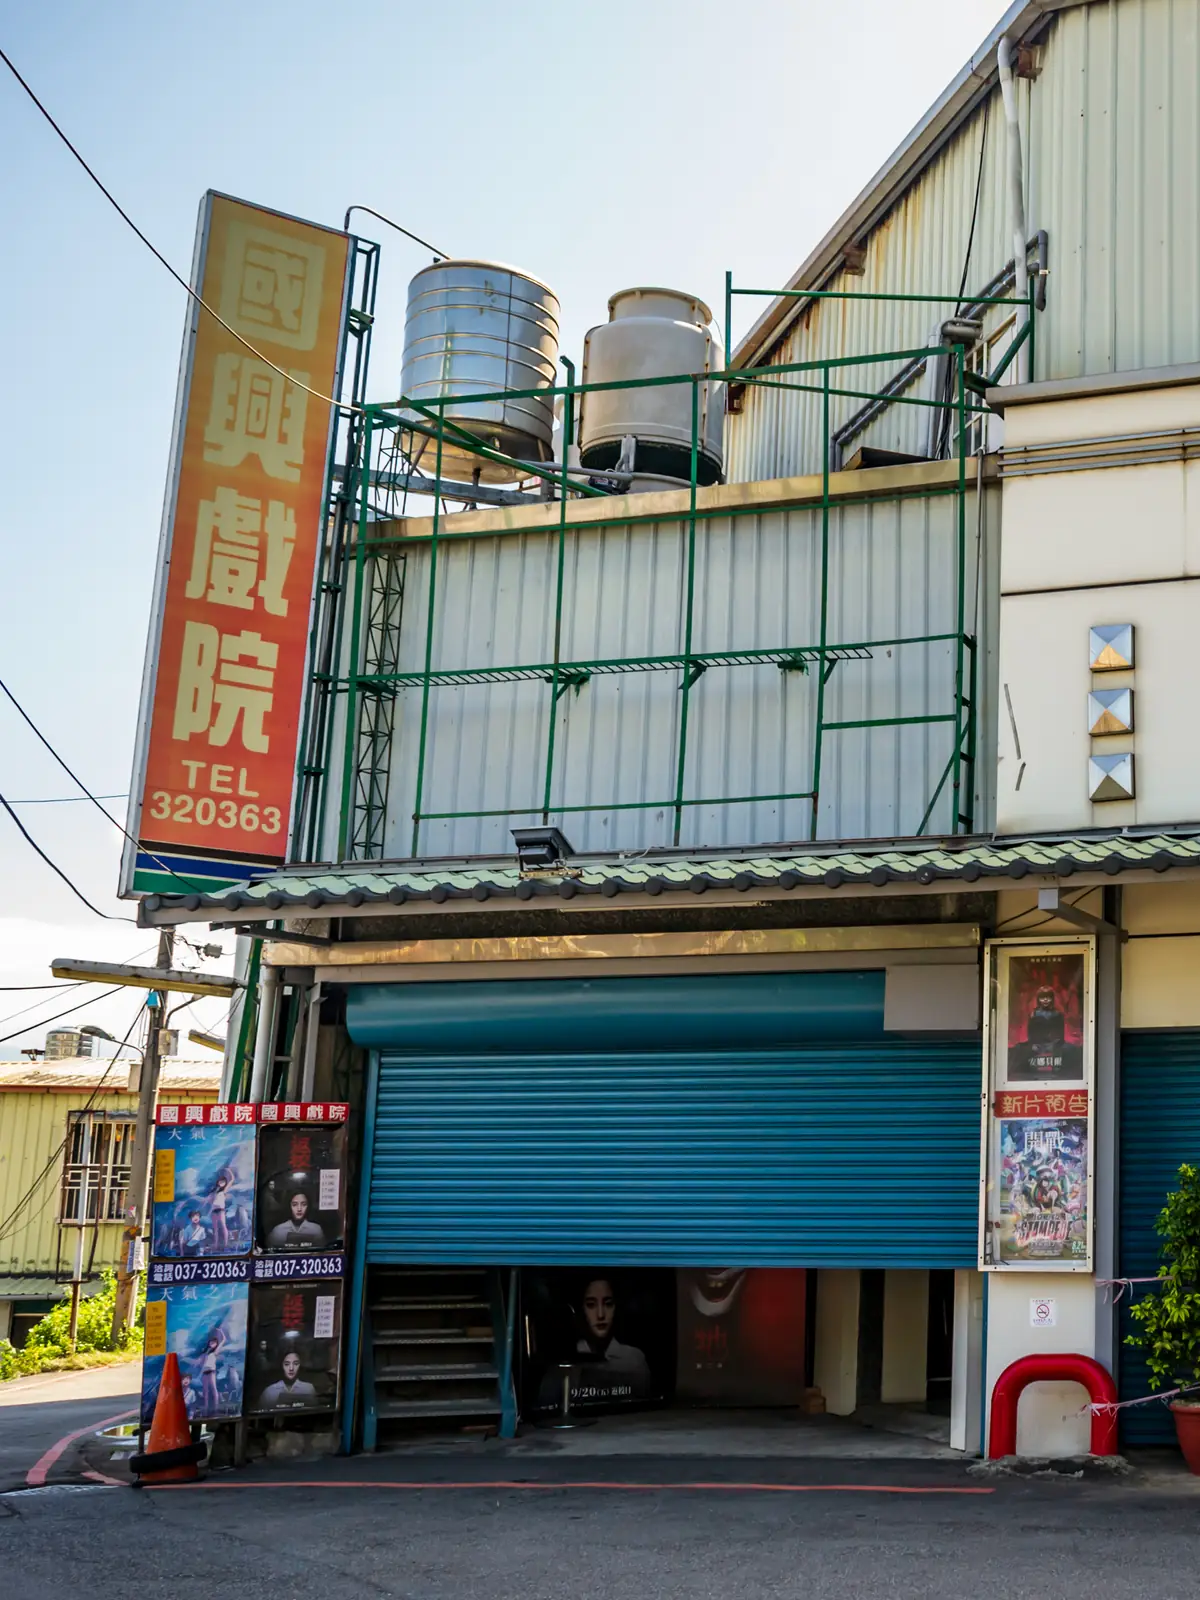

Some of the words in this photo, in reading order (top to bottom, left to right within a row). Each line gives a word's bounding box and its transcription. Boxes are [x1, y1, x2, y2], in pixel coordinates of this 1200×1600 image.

[172, 218, 327, 755] 國興戲院
[181, 759, 260, 798] TEL
[150, 790, 281, 834] 320363
[261, 1104, 346, 1121] 國興戲院
[1002, 1093, 1088, 1114] 新片預告
[159, 1105, 253, 1123] 國興戲院
[174, 1261, 247, 1281] 037-320363
[274, 1257, 342, 1277] 037-320363
